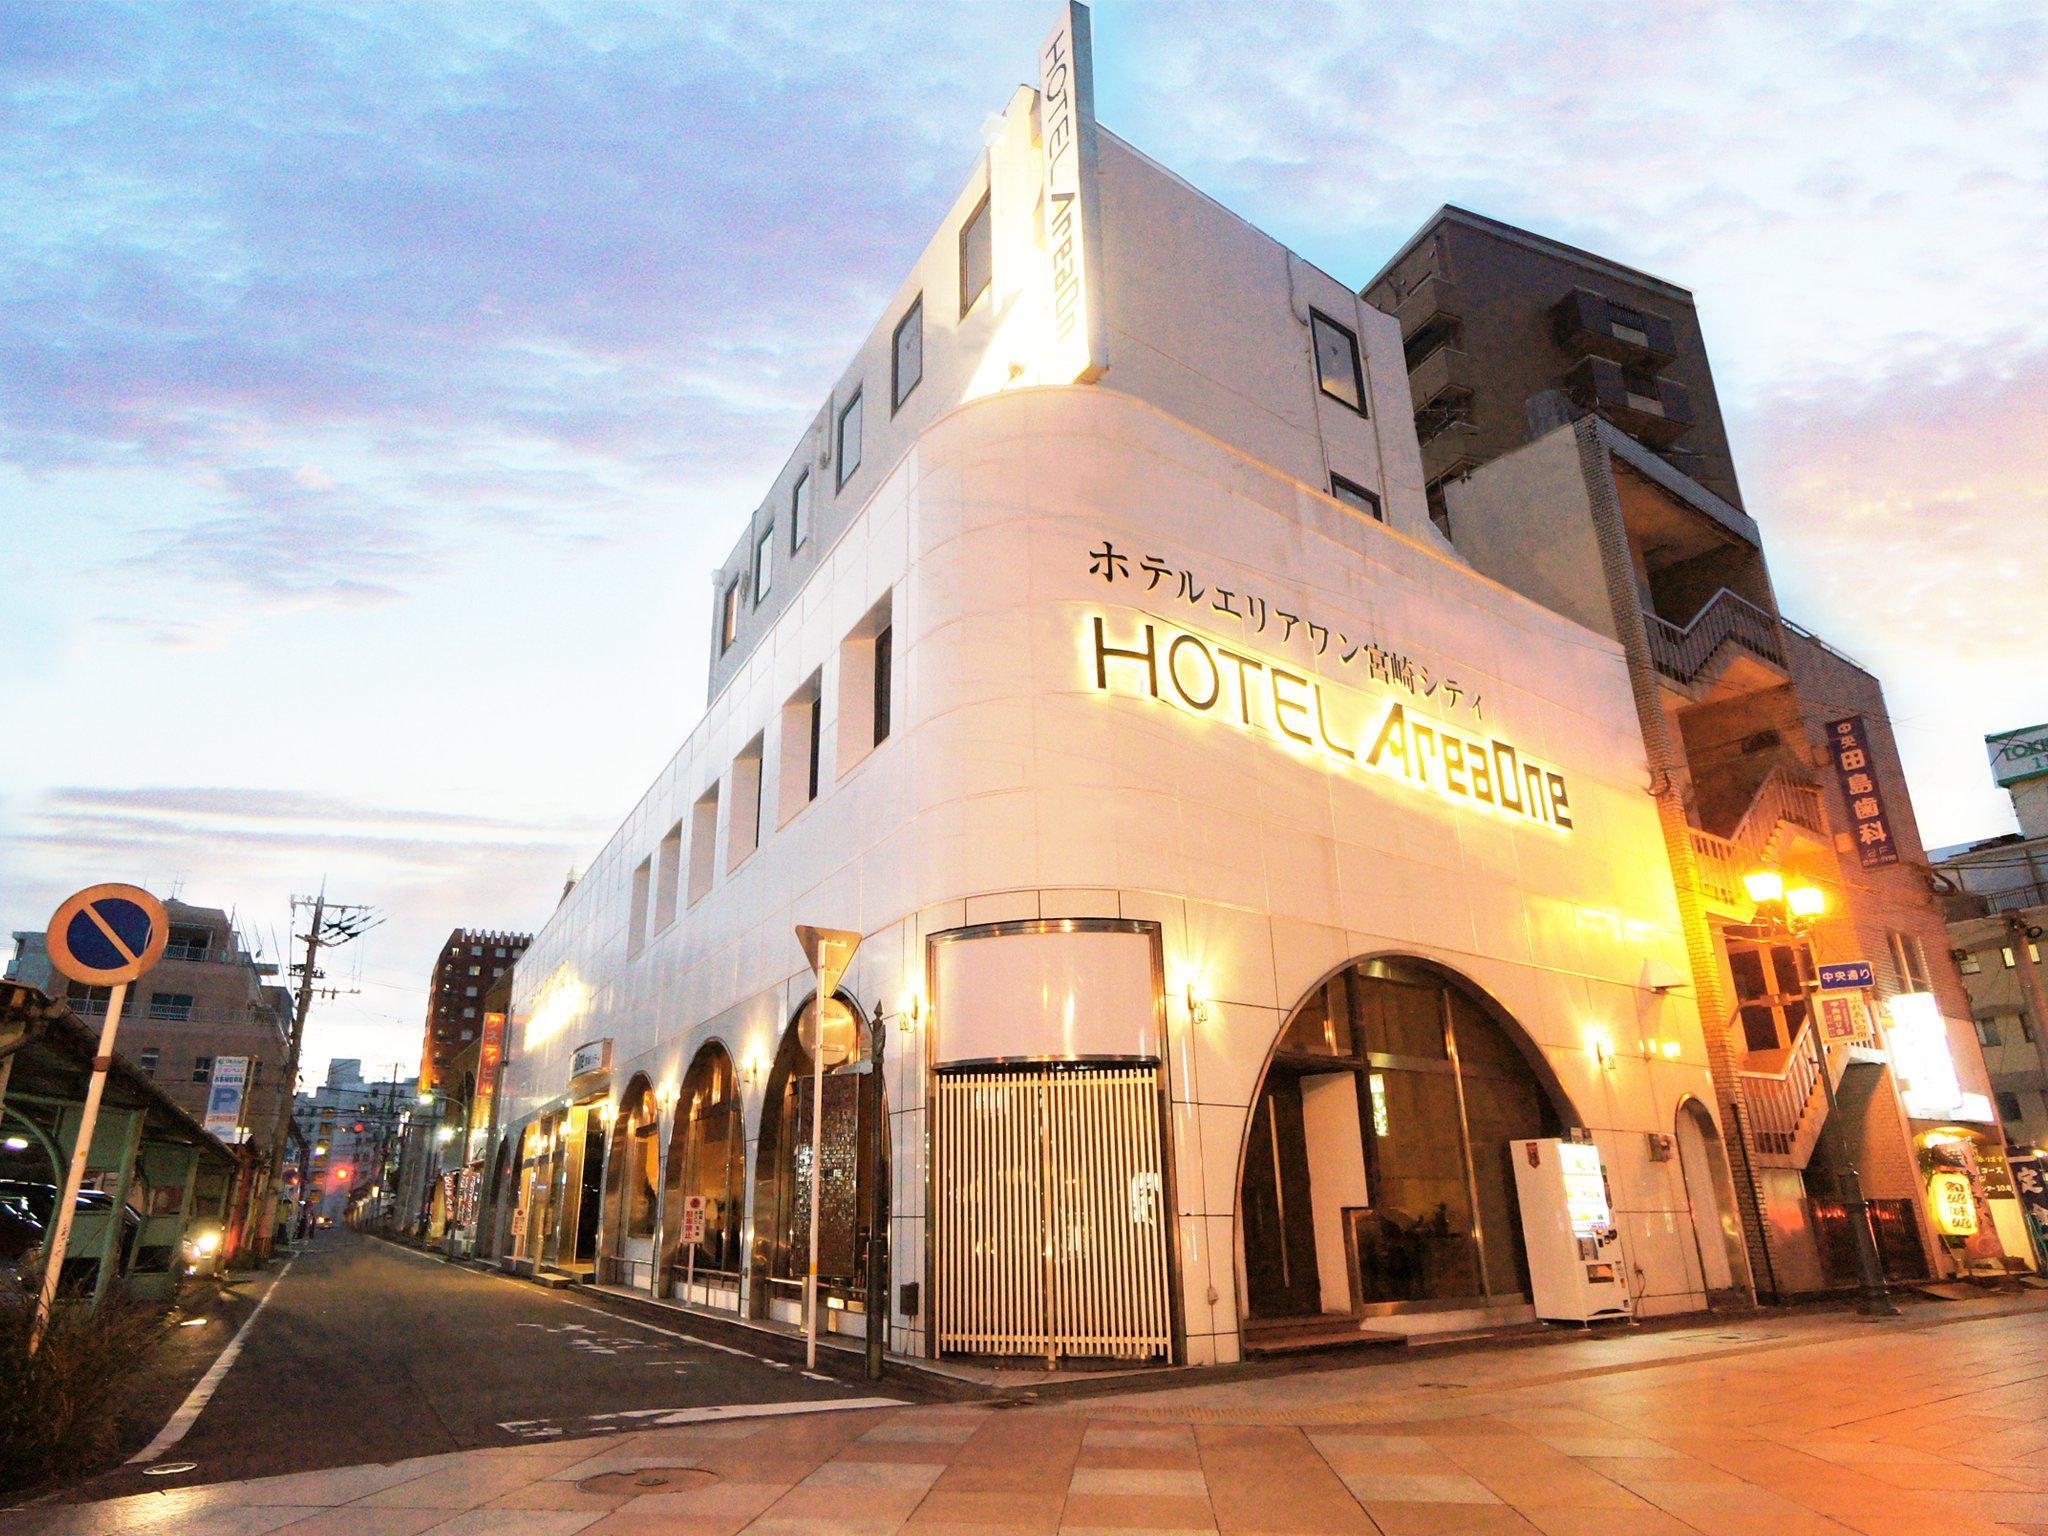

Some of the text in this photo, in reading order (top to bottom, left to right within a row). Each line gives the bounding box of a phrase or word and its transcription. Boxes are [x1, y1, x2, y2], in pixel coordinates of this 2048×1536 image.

[1045, 30, 1080, 345] HOTEL AreaOn
[1089, 541, 1483, 721] ホテルエリアワン宮崎シティ
[1093, 617, 1574, 831] HOTEL AreaOne
[1822, 968, 1870, 982] 中央通り
[213, 1087, 239, 1110] P
[1977, 1165, 2005, 1175] コース
